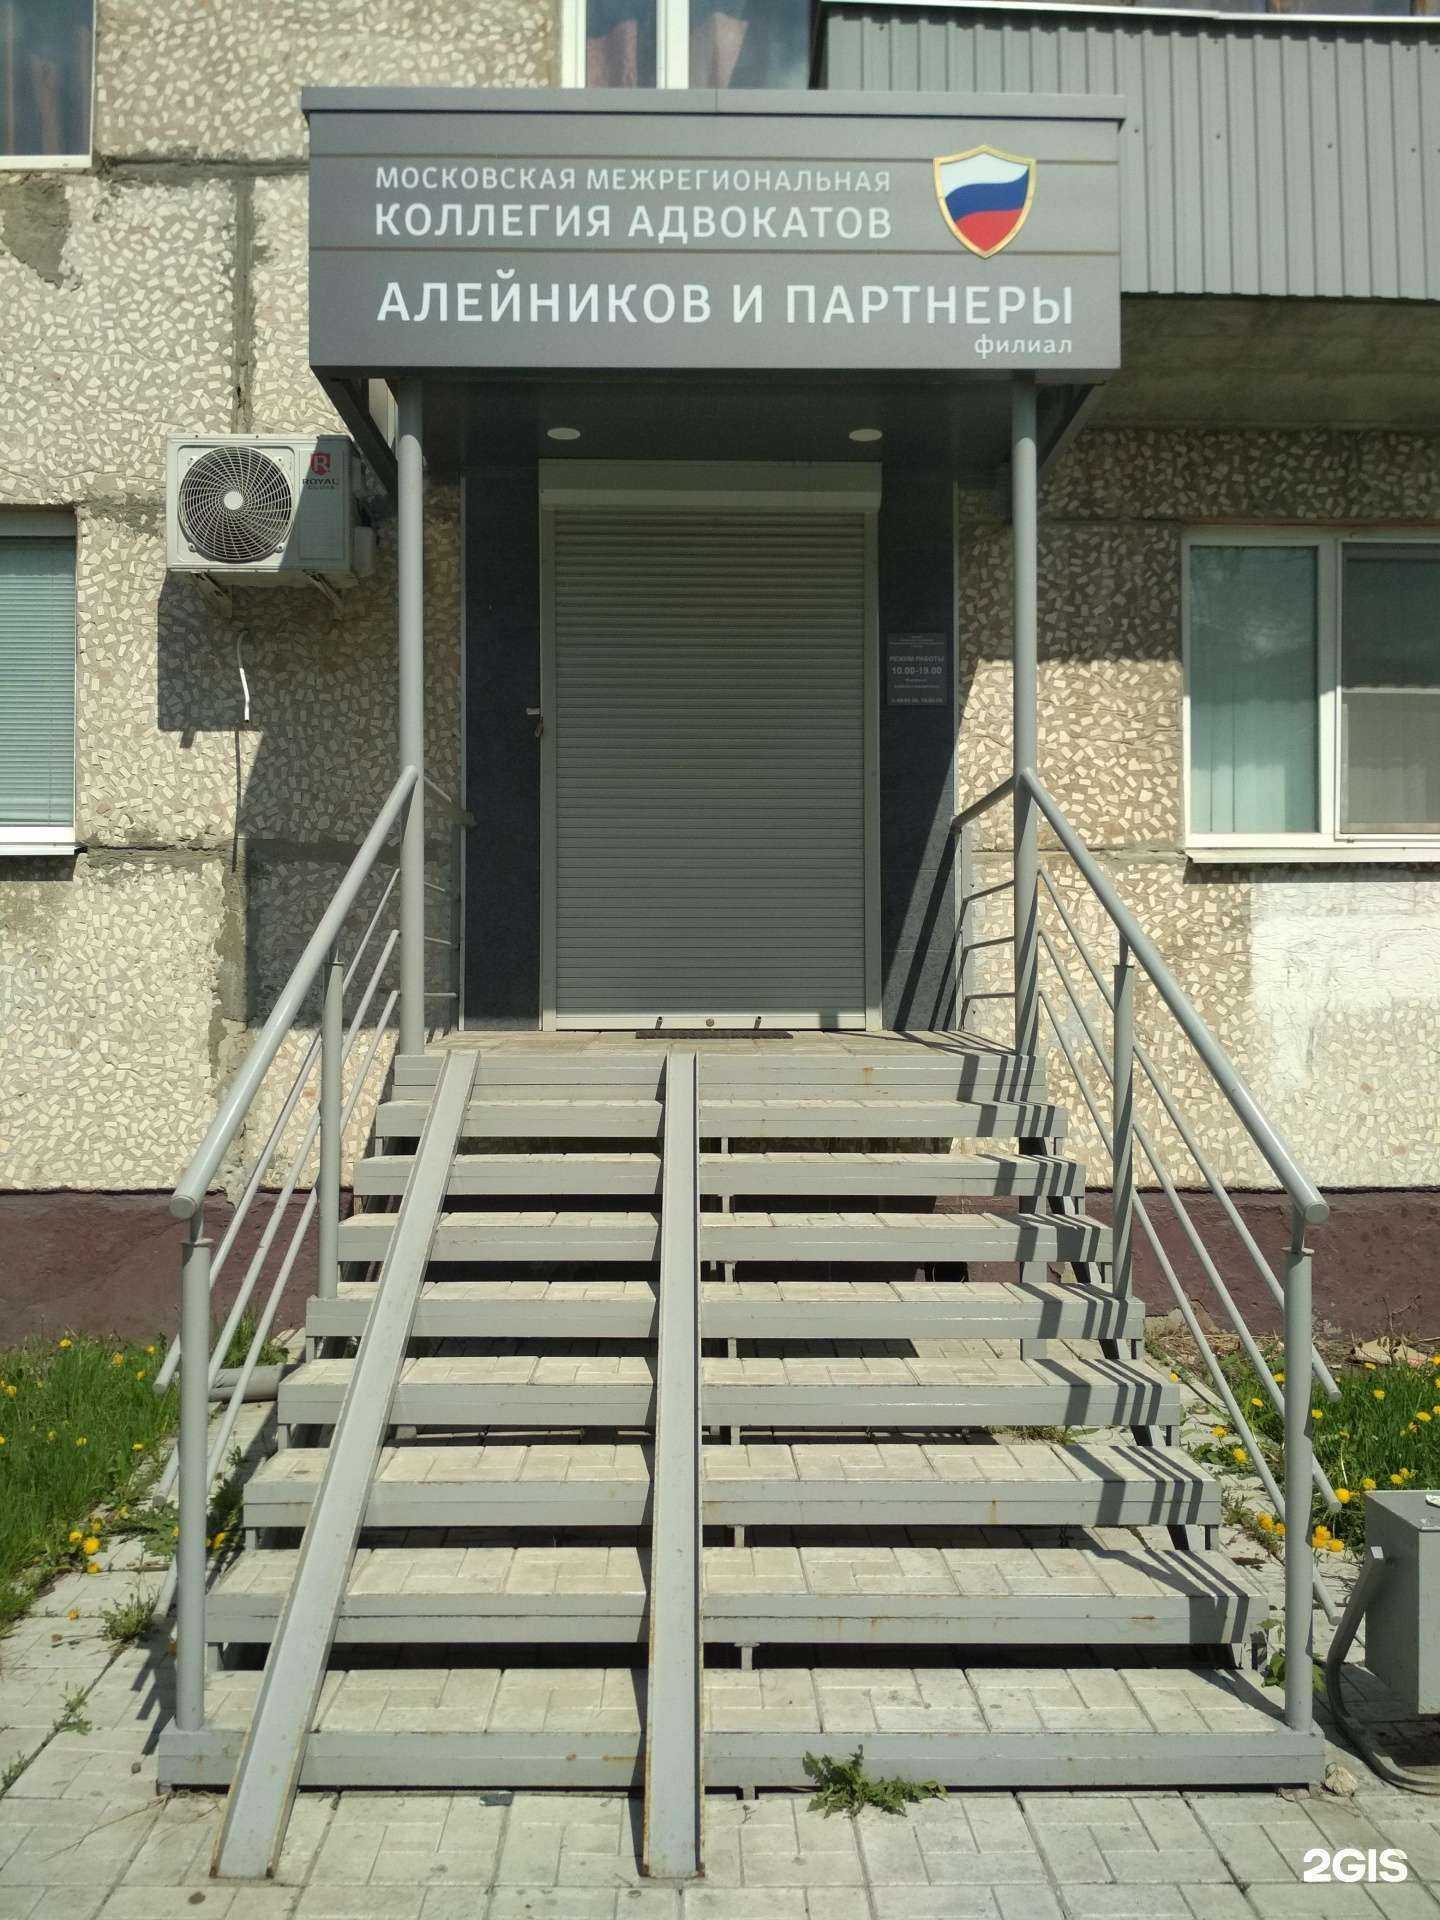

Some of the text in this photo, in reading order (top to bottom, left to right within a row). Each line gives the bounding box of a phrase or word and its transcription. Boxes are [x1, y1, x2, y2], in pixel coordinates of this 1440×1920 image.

[375, 166, 891, 192] МОСКОВСКАЯ МЕЖРЕГИОНАЛЬНАЯ
[375, 202, 892, 244] КОЛЛЕГИЯ АДВОКАТОВ
[376, 267, 1073, 325] АЛЕЙНИКОВ И ПАРТНЕРЫ
[974, 333, 1073, 360] филиал
